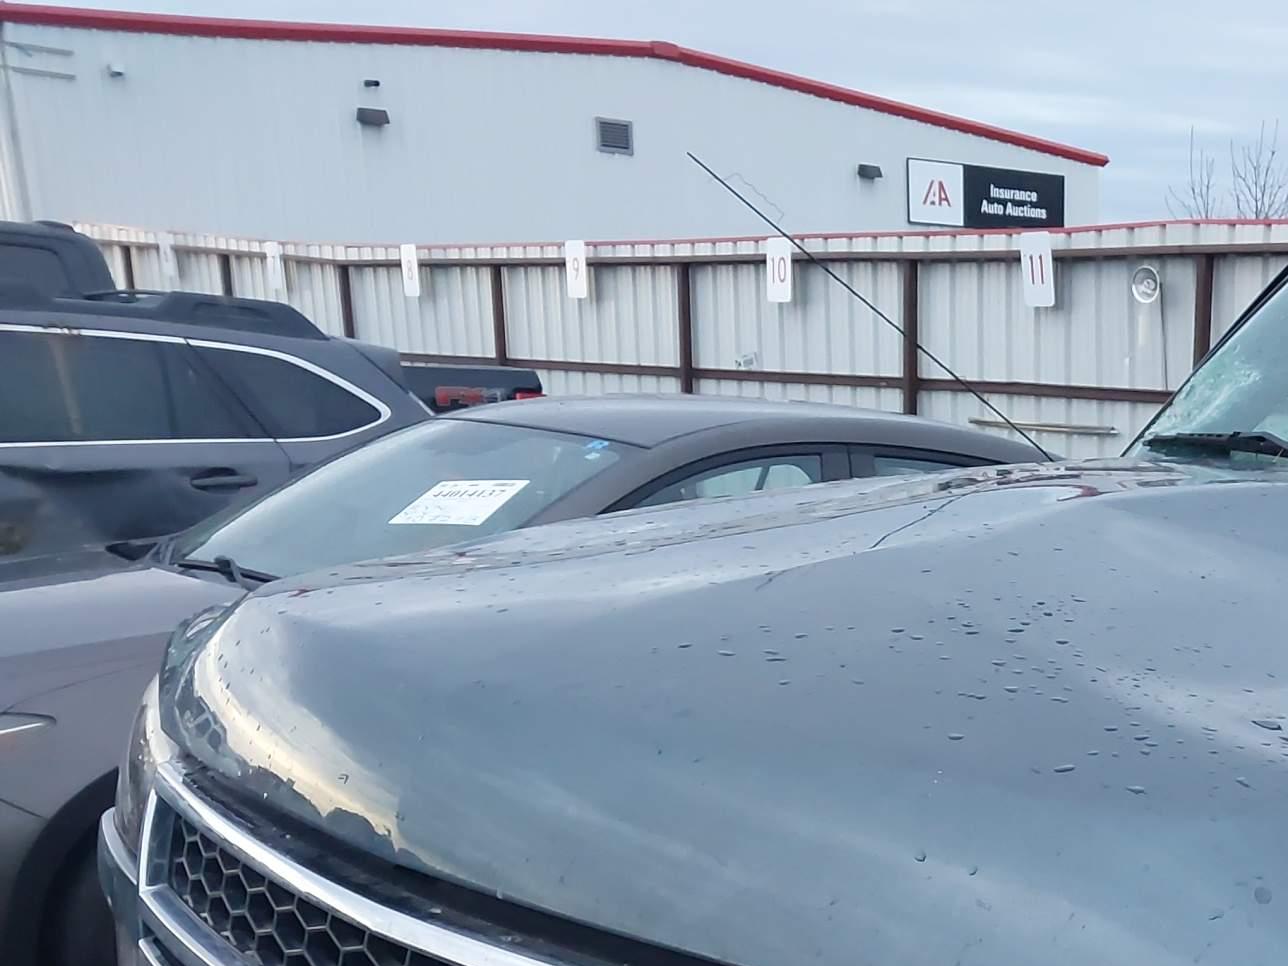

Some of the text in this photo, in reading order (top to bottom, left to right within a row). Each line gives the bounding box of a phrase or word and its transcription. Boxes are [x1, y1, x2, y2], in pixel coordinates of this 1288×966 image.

[989, 183, 1038, 203] Insurance
[980, 199, 1047, 220] Auto Auctions
[571, 257, 580, 280] 9
[770, 255, 787, 284] 10
[1029, 253, 1045, 285] 11
